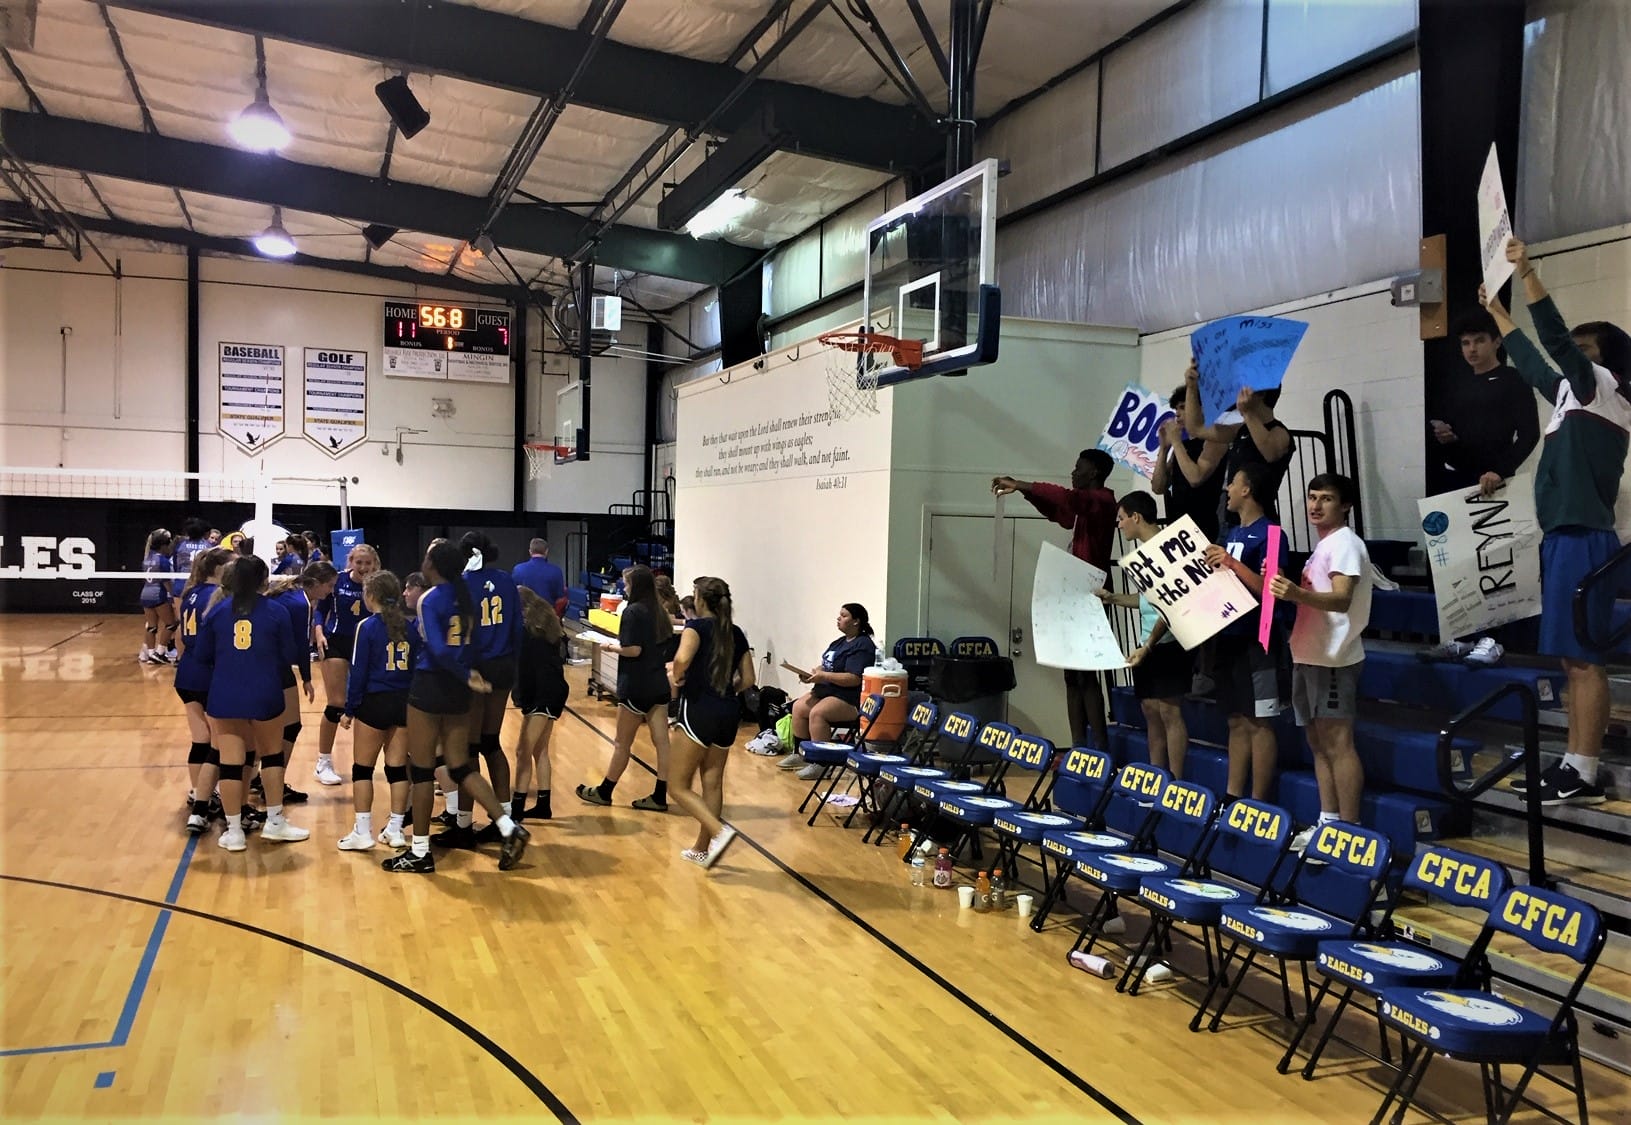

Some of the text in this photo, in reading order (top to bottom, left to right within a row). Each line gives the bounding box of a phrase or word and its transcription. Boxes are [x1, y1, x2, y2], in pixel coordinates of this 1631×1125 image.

[385, 306, 417, 319] HOME
[478, 315, 508, 326] GUEST
[399, 321, 415, 338] 11
[498, 328, 508, 345] 7
[224, 346, 280, 359] BASEBALL
[318, 352, 353, 364] GOLF
[758, 423, 769, 435] Lord
[769, 418, 782, 433] shall
[783, 419, 797, 430] renew
[798, 412, 813, 426] their
[753, 445, 760, 459] up
[761, 440, 771, 452] with
[772, 437, 786, 454] wings
[787, 438, 794, 448] as
[794, 432, 813, 451] eagles;
[759, 458, 768, 470] and
[769, 457, 779, 474] they
[780, 454, 793, 468] shall
[809, 450, 821, 464] and
[821, 452, 831, 463] not
[830, 446, 850, 468] faint.
[816, 478, 832, 489] Isaiah
[1159, 530, 1196, 564] me
[1429, 535, 1449, 568] #8
[1464, 482, 1516, 597] REYNA
[1183, 551, 1216, 586] Ne
[1156, 578, 1190, 606] the
[350, 600, 361, 616] 4
[481, 595, 503, 627] 12
[1221, 602, 1238, 618] #4
[183, 608, 197, 635] 14
[234, 619, 252, 650] 8
[386, 641, 410, 671] 13
[905, 642, 941, 656] CFCA
[958, 642, 993, 655] CFCA
[944, 714, 972, 738] CFCA
[980, 726, 1012, 750] CFCA
[1008, 738, 1044, 765] CFCA
[1066, 750, 1105, 779] CFCA
[1120, 766, 1163, 797] CFCA
[1161, 784, 1206, 818] CFCA
[997, 818, 1016, 833] EAGLES
[1228, 802, 1281, 841] CFCA
[1047, 839, 1067, 857] EAGLES
[1316, 826, 1378, 867] CFCA
[1080, 862, 1101, 881] EAGLES
[1417, 852, 1492, 899] CFCA
[1144, 888, 1169, 908] EAGLES
[1226, 917, 1256, 939] EAGLES
[1502, 890, 1582, 947] CFCA
[1327, 955, 1363, 981] EAGLES
[1390, 1005, 1429, 1035] EAGLES
